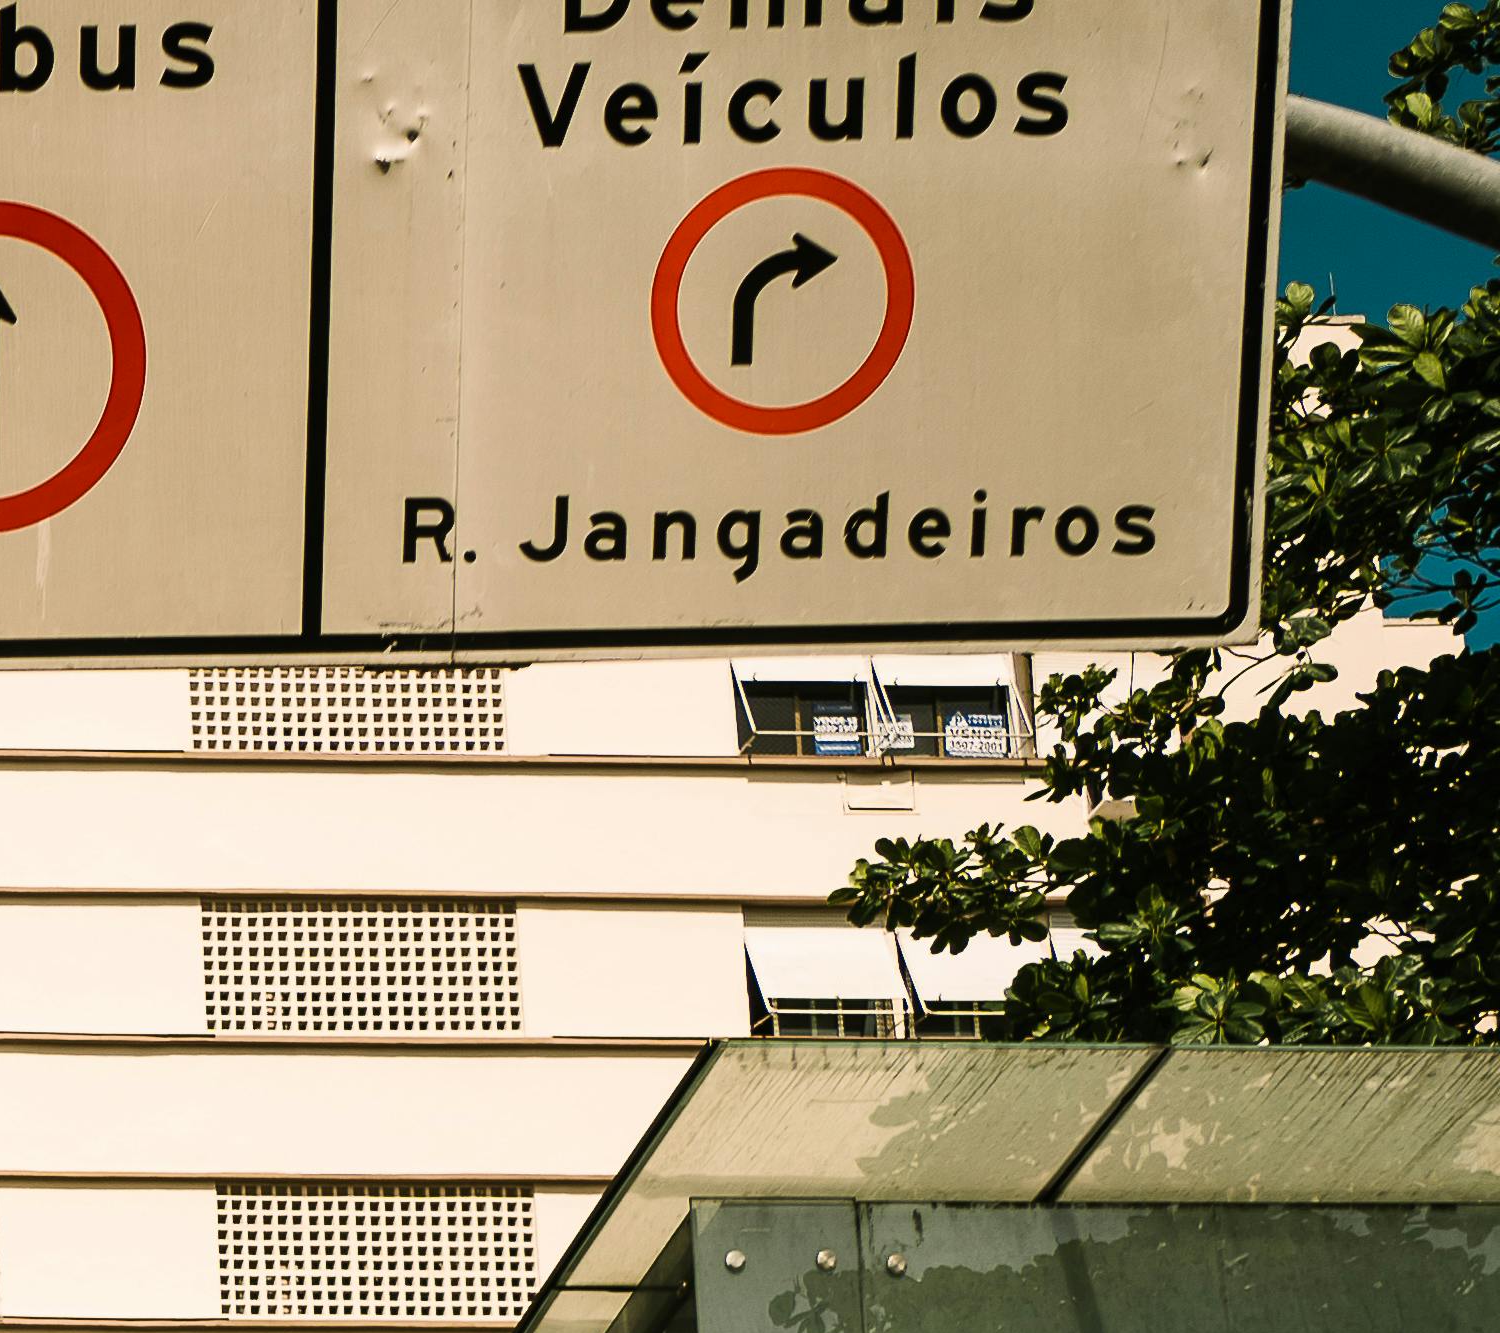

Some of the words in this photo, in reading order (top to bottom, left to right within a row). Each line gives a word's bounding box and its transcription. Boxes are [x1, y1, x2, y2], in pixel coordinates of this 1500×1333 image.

[516, 52, 1071, 149] Veículos
[402, 496, 477, 563] R.
[518, 490, 1156, 585] Jangadeiros
